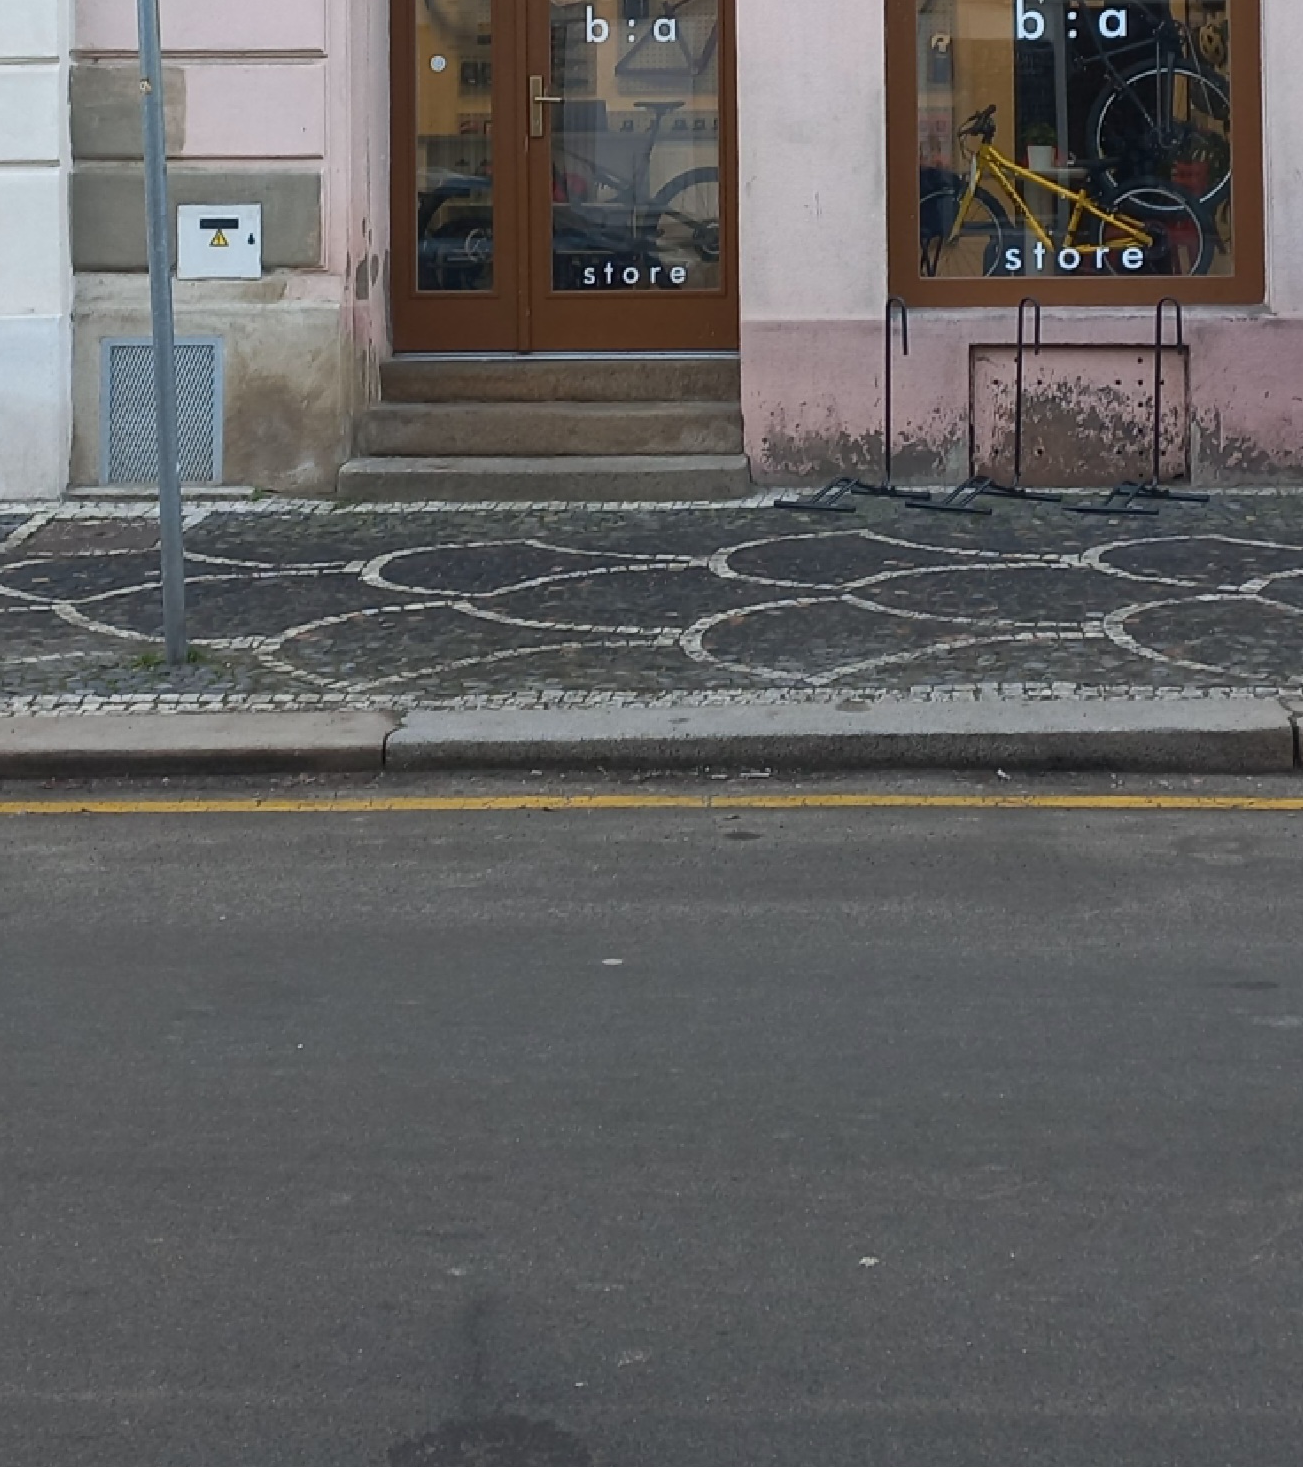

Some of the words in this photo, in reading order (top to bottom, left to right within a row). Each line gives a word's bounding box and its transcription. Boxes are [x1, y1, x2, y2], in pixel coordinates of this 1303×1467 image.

[585, 5, 678, 44] b:a
[1004, 243, 1145, 272] store
[581, 260, 688, 286] store
